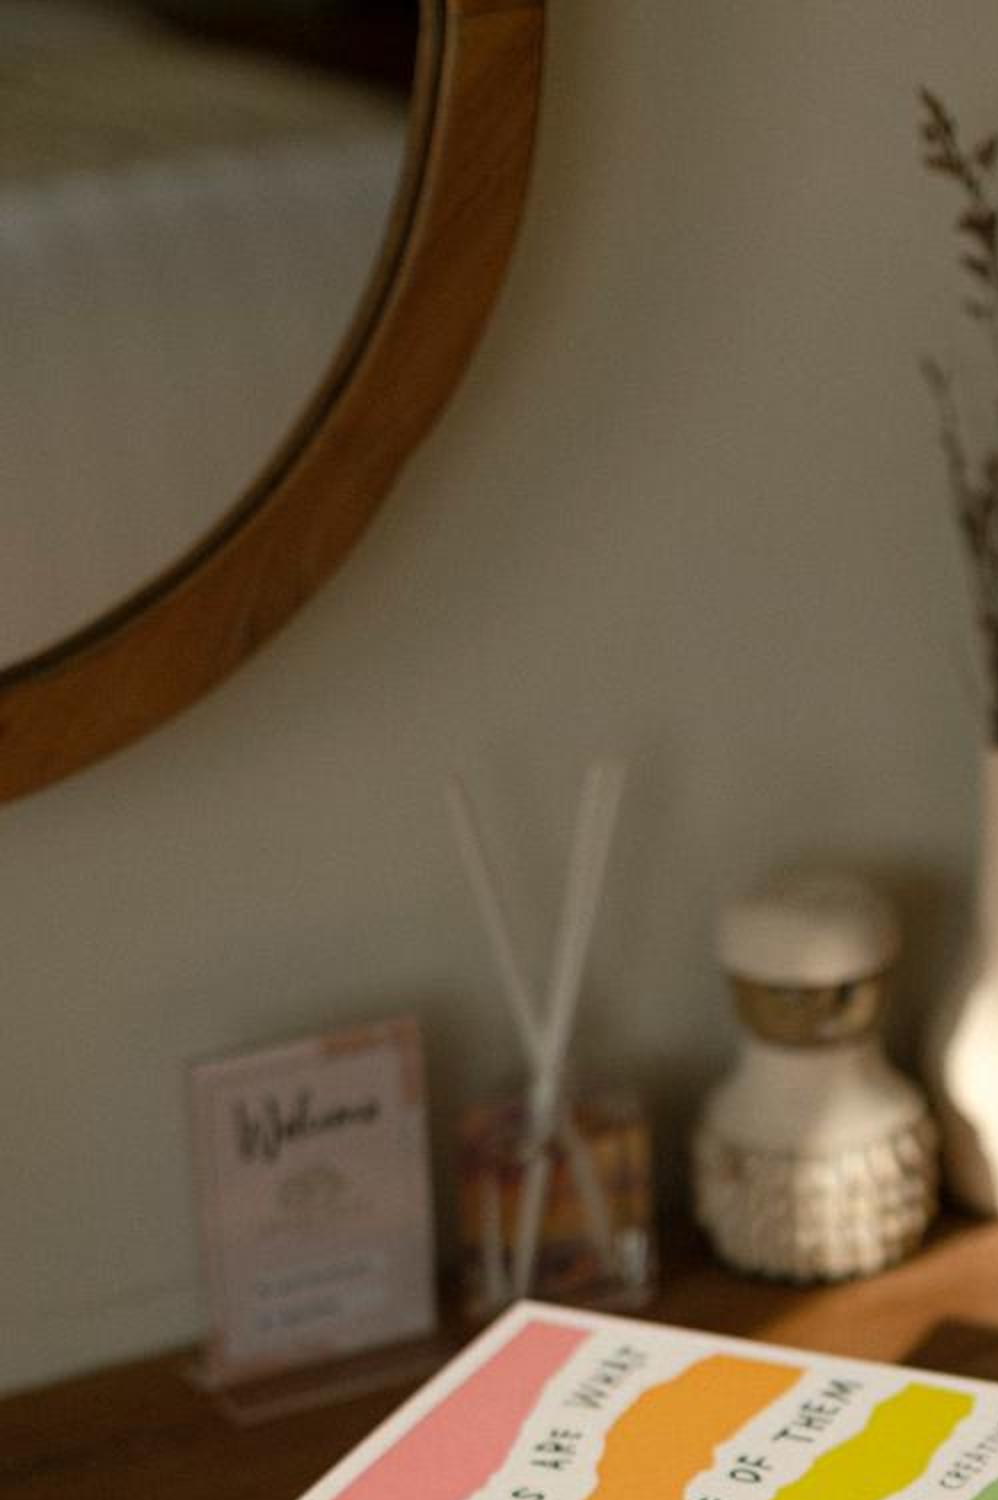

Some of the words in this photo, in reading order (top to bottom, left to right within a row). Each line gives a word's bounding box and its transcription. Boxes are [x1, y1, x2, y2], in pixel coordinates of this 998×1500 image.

[529, 1428, 584, 1471] ARE
[728, 1454, 773, 1485] OF
[771, 1378, 863, 1444] THEM
